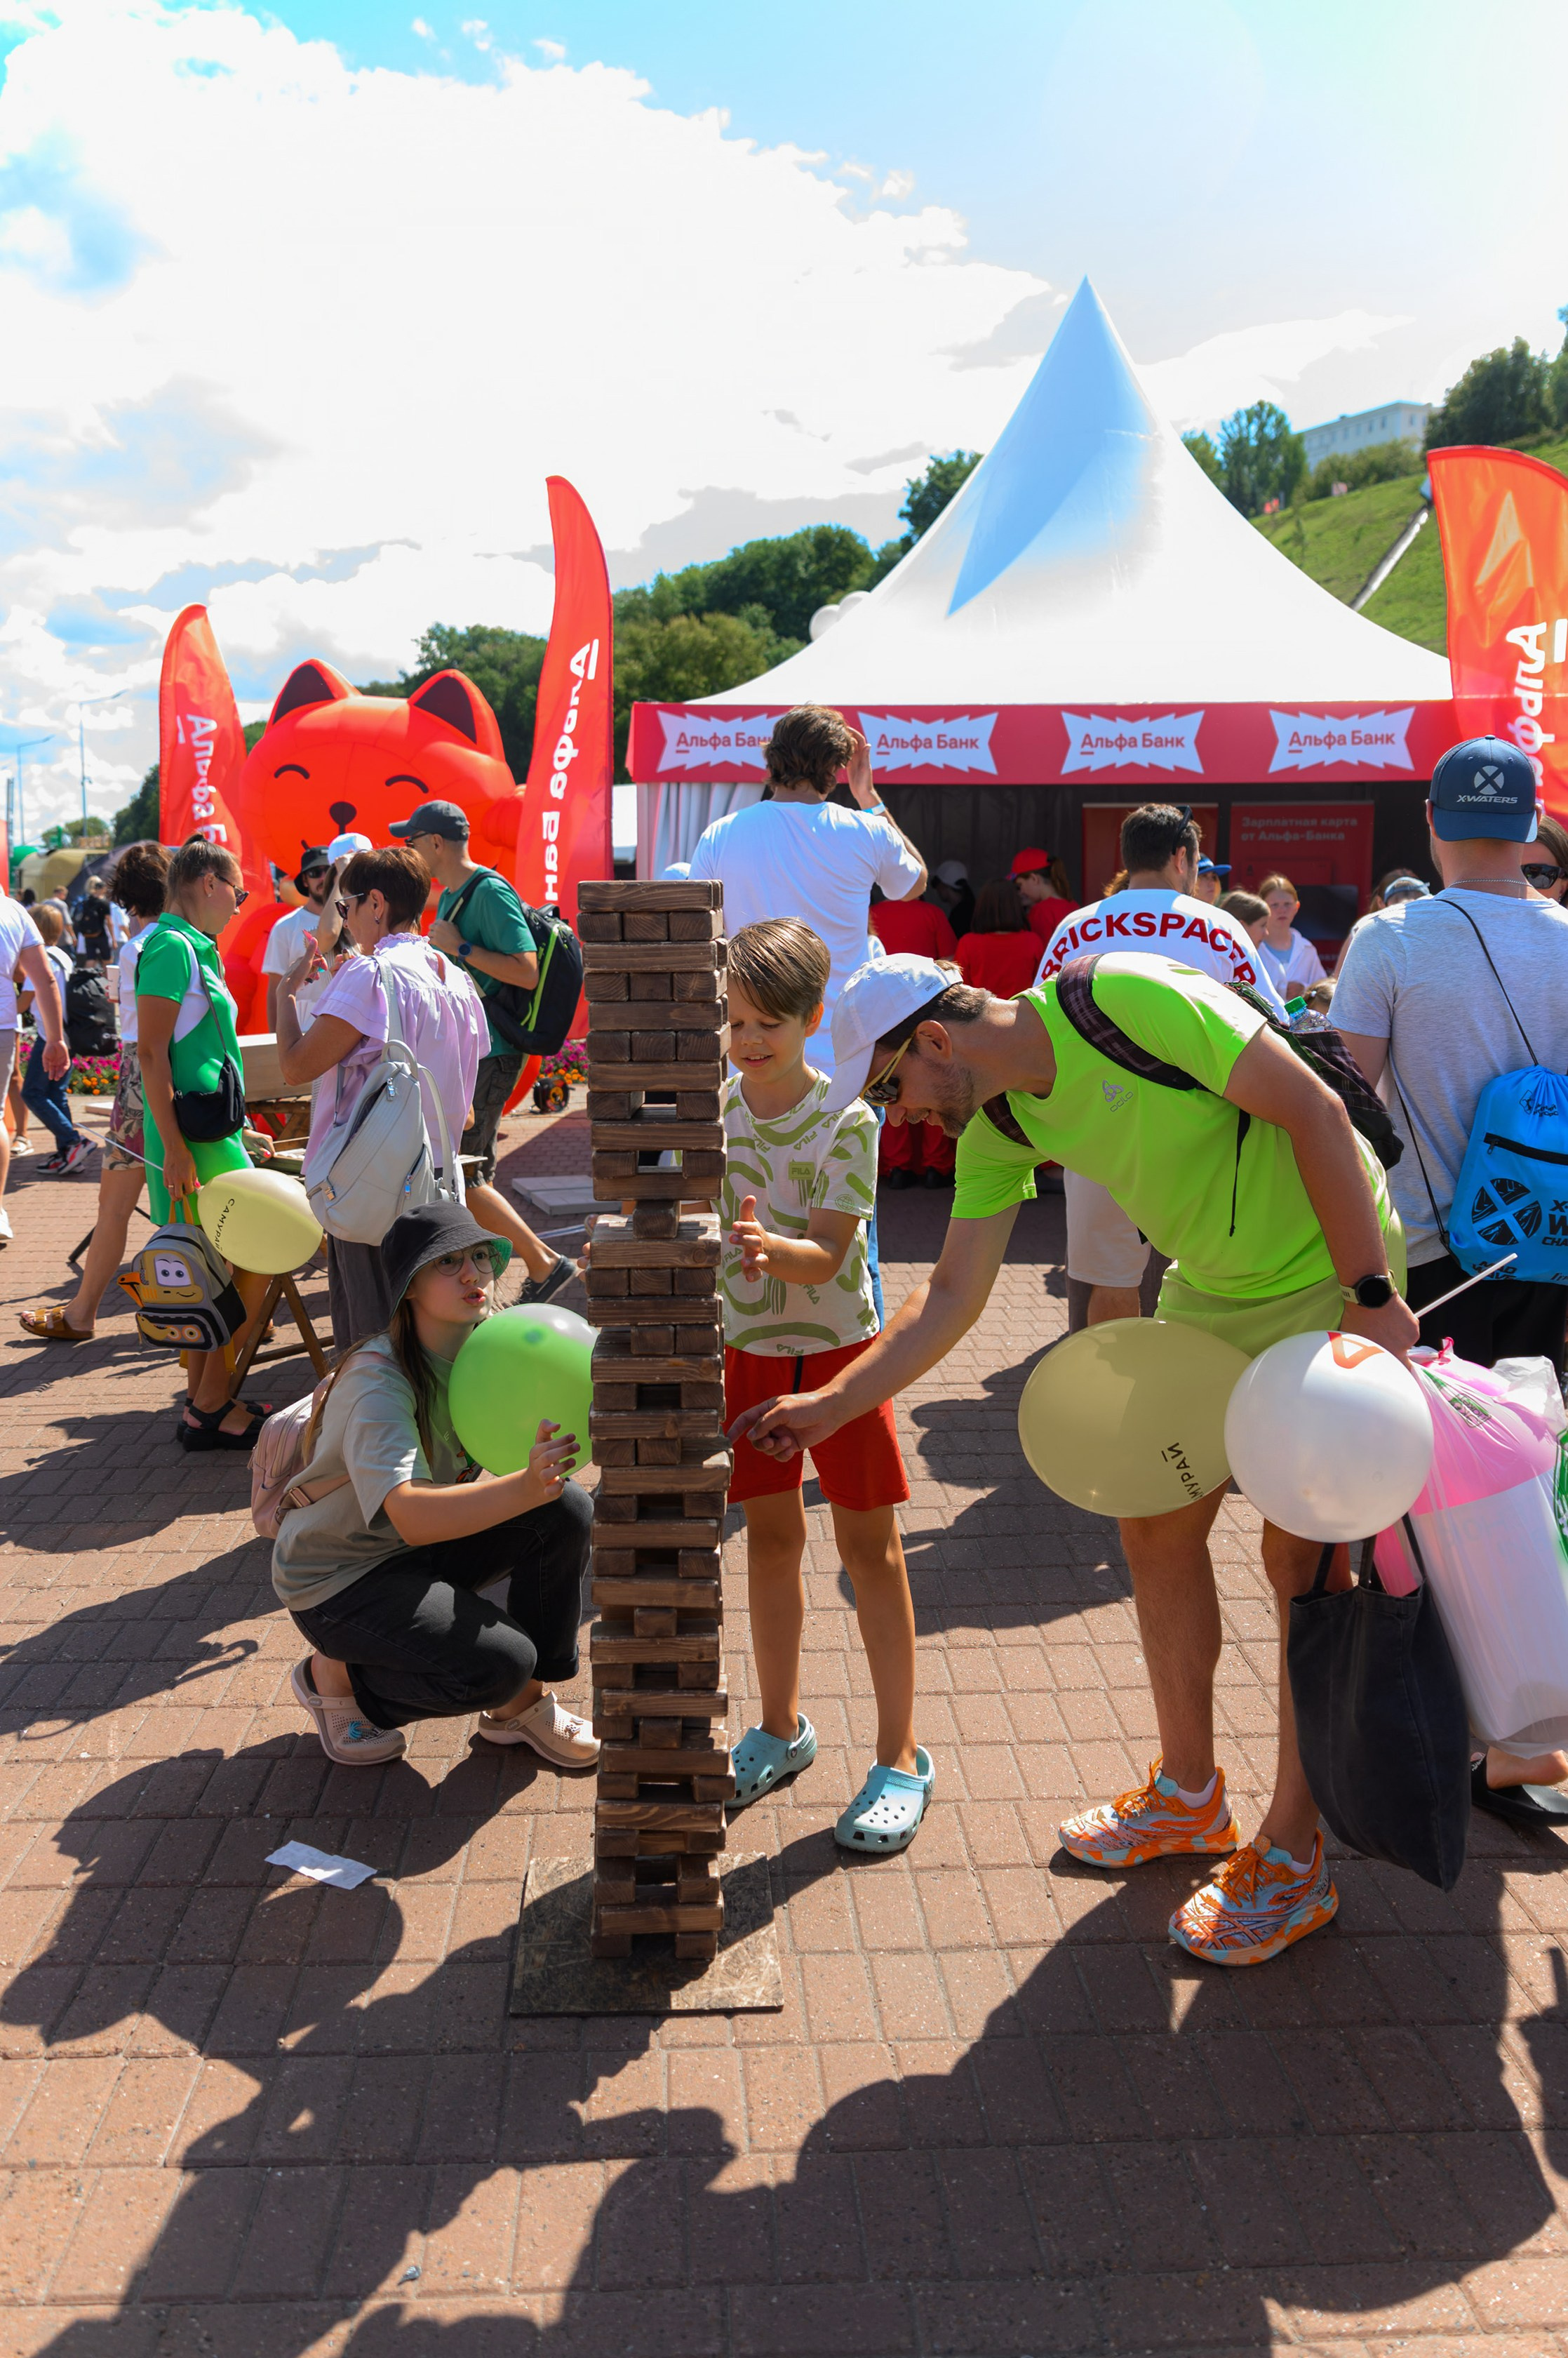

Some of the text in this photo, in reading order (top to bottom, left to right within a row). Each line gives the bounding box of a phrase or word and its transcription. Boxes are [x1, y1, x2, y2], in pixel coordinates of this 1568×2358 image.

[676, 731, 731, 754] Альфа
[876, 733, 979, 755] Альфа Банк
[1080, 733, 1185, 755] Альфа Банк
[1288, 730, 1395, 753] Альфа Банк
[1242, 817, 1358, 828] Зарплатная карта
[1241, 831, 1346, 842] от Альфа-Банка
[1041, 912, 1257, 986] BRICKSPACER
[1110, 1091, 1134, 1112] odlo
[793, 1131, 818, 1150] FILA
[215, 1198, 235, 1252] САМУРАЙ
[724, 1247, 743, 1263] FILA
[803, 1283, 820, 1305] FILA
[776, 1343, 805, 1356] FILA
[1161, 1442, 1205, 1500] МУРАЙ
